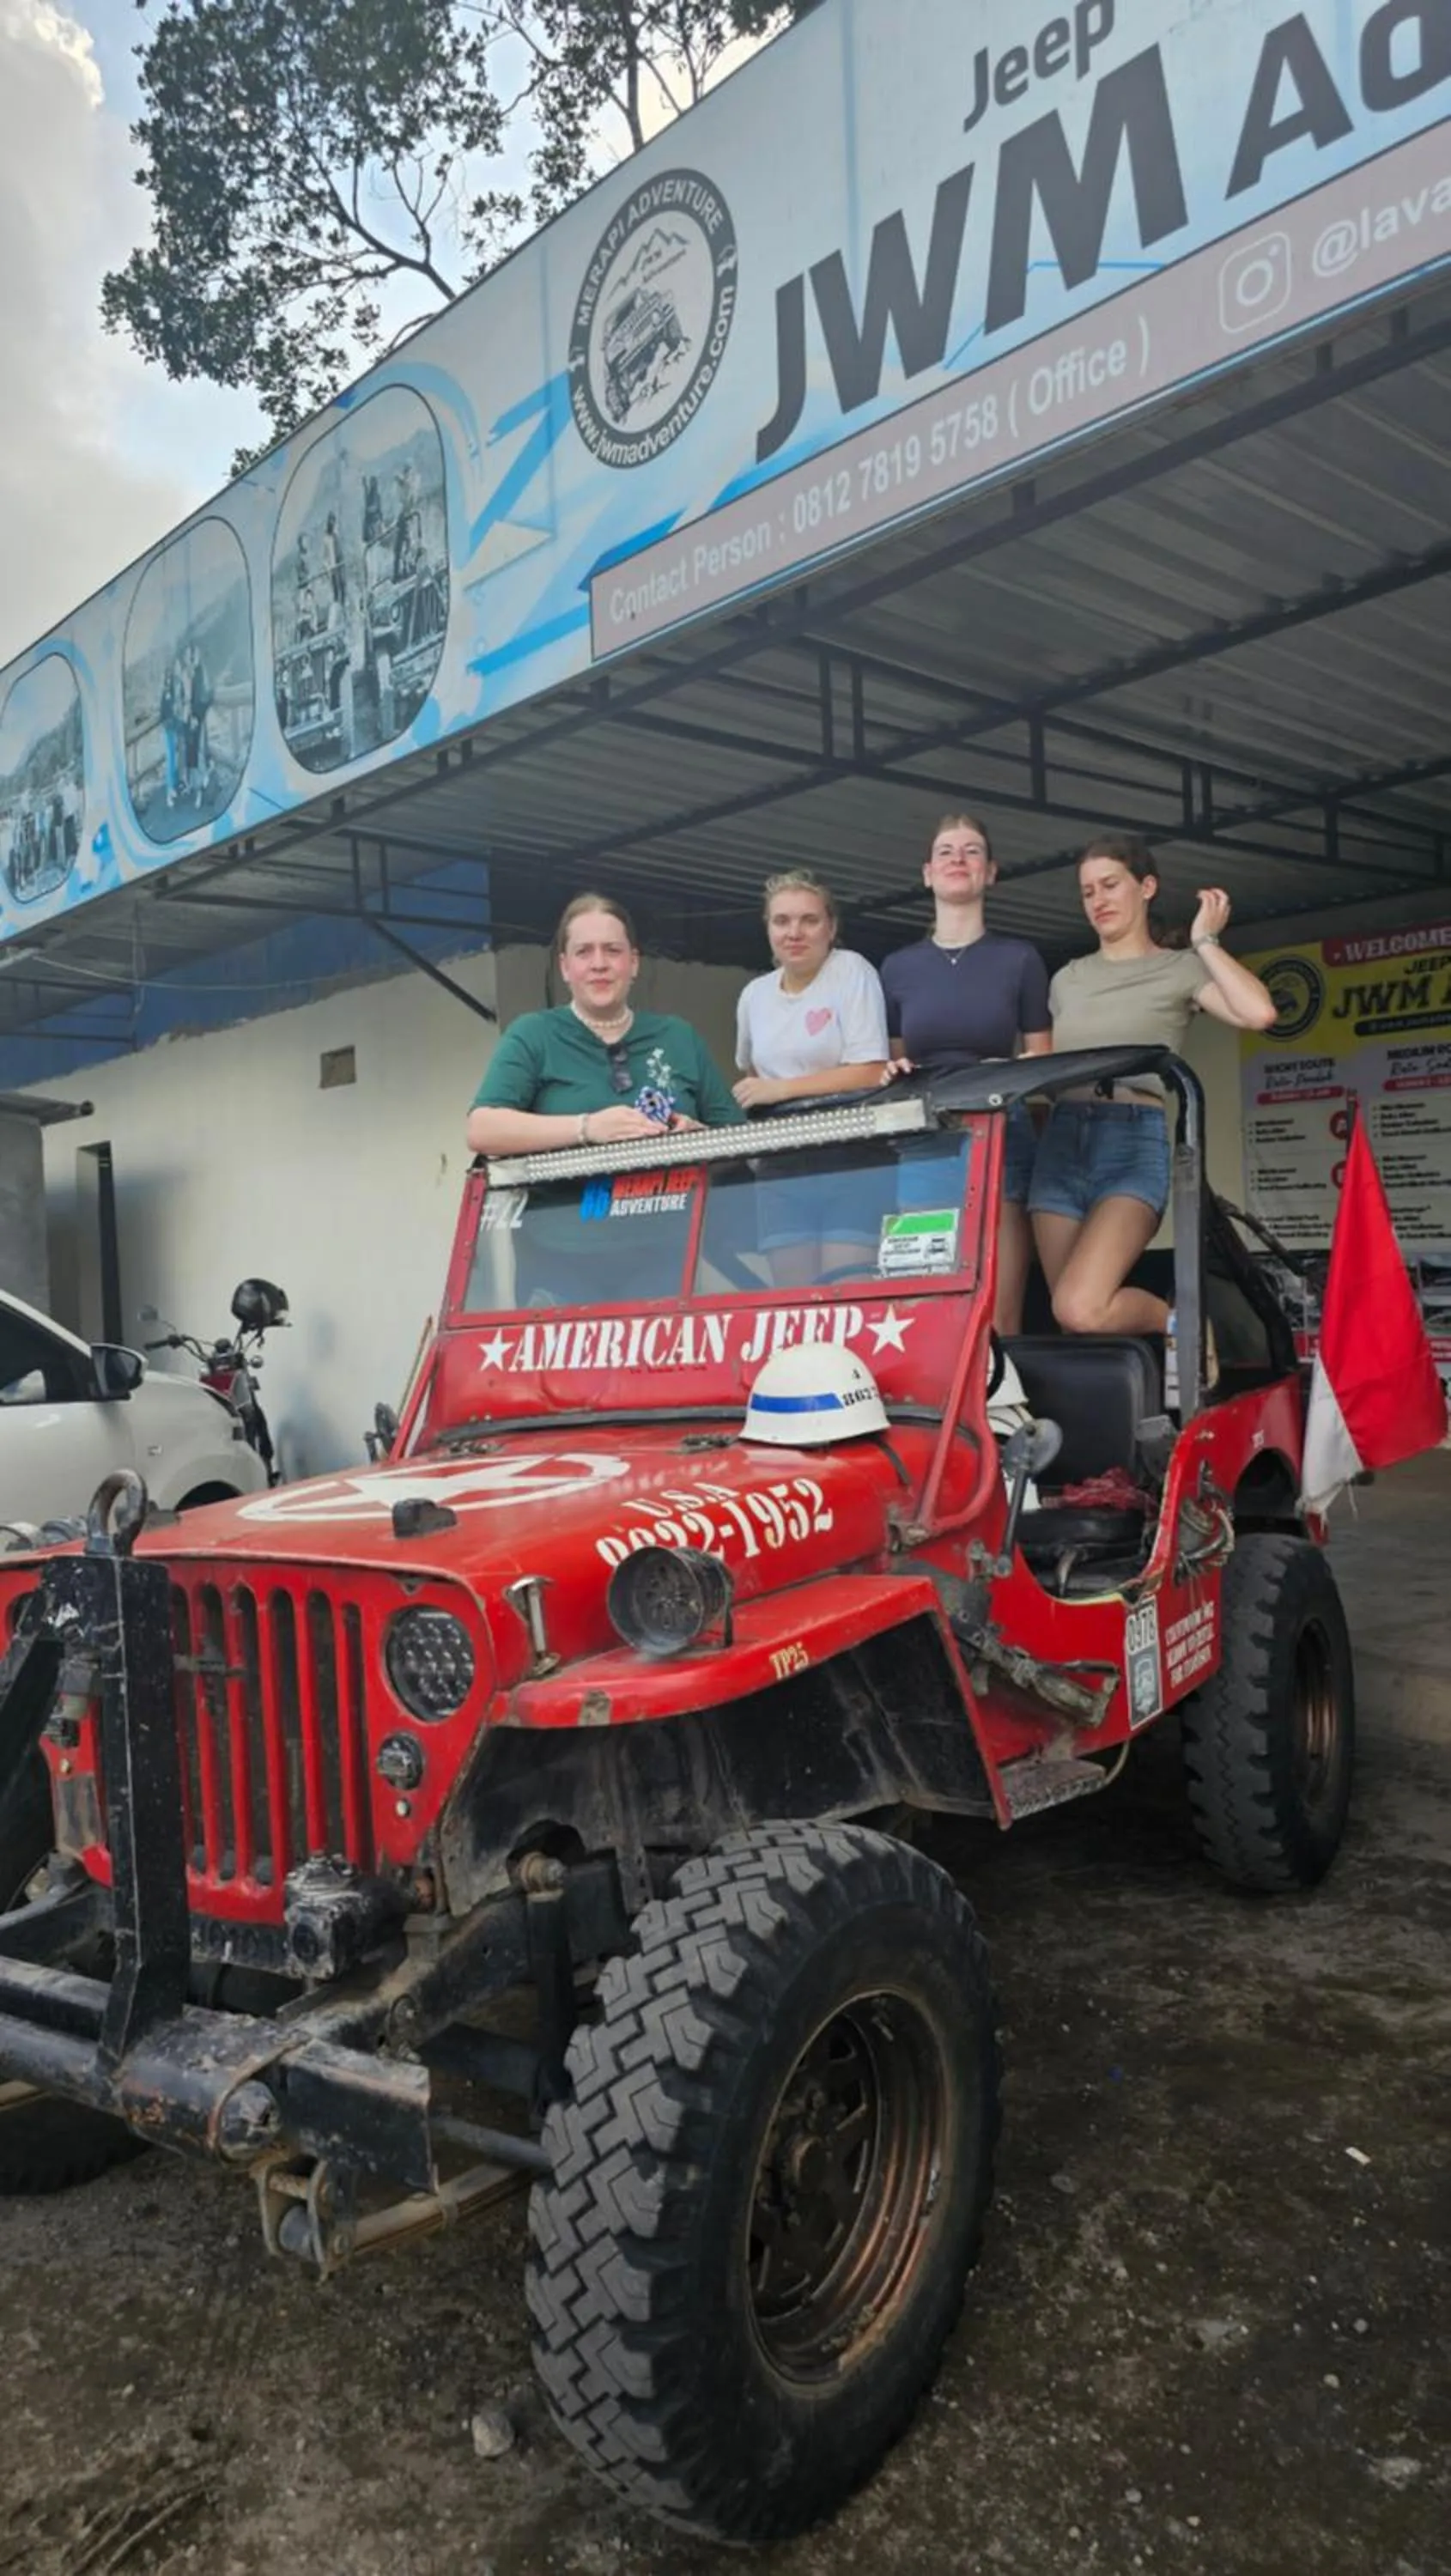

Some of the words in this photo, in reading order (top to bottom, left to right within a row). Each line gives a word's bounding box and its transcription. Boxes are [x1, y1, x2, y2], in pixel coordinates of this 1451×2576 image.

[963, 0, 1114, 134] Jeep
[577, 223, 626, 326] MERAPI
[626, 179, 724, 235] ADVENTURE
[756, 43, 1189, 465] JWM
[573, 285, 734, 465] www.jwmadventure.com
[610, 574, 688, 625] Contact
[694, 520, 771, 585] Person
[792, 471, 851, 533] 0812
[859, 435, 921, 502] 7819
[930, 394, 999, 465] 5758
[1029, 340, 1127, 415] Office
[1333, 975, 1433, 1018] JWM
[610, 1193, 688, 1217] ADVENTURE
[509, 1313, 733, 1374] AMERICAN
[741, 1304, 865, 1364] JEEP
